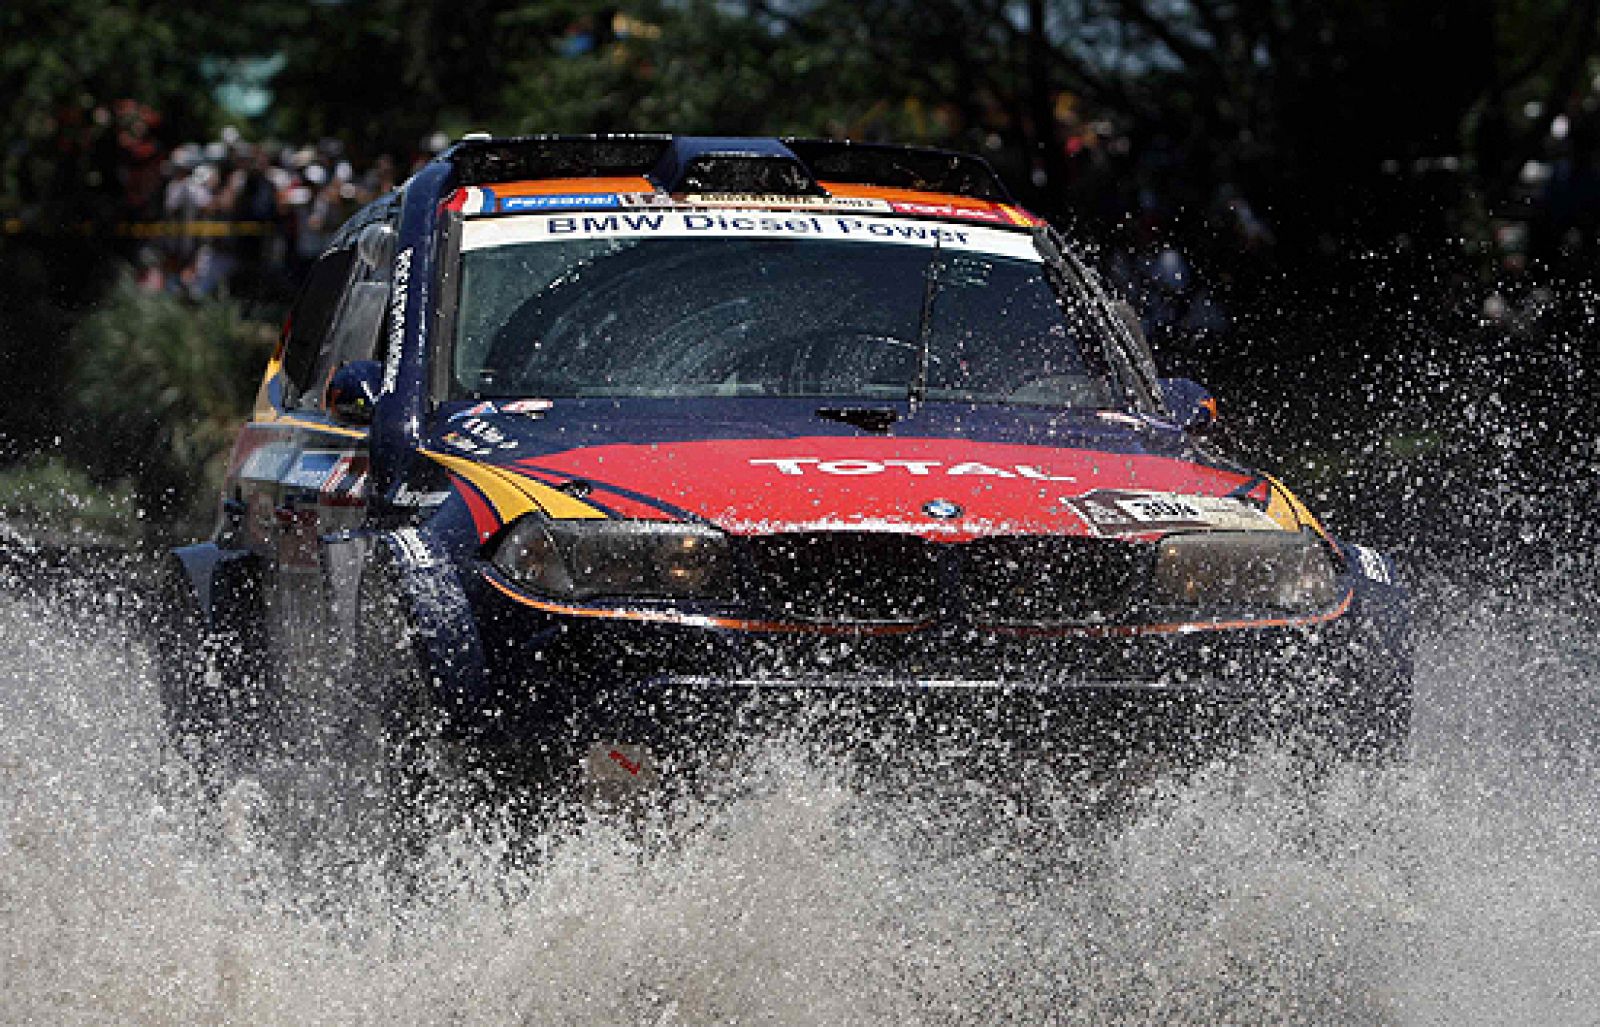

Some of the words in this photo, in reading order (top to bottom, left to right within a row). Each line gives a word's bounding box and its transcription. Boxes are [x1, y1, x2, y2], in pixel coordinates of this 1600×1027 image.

[547, 214, 665, 234] BMW
[683, 214, 825, 234] Diesel
[837, 217, 970, 245] Power
[748, 457, 1077, 484] TOTAL
